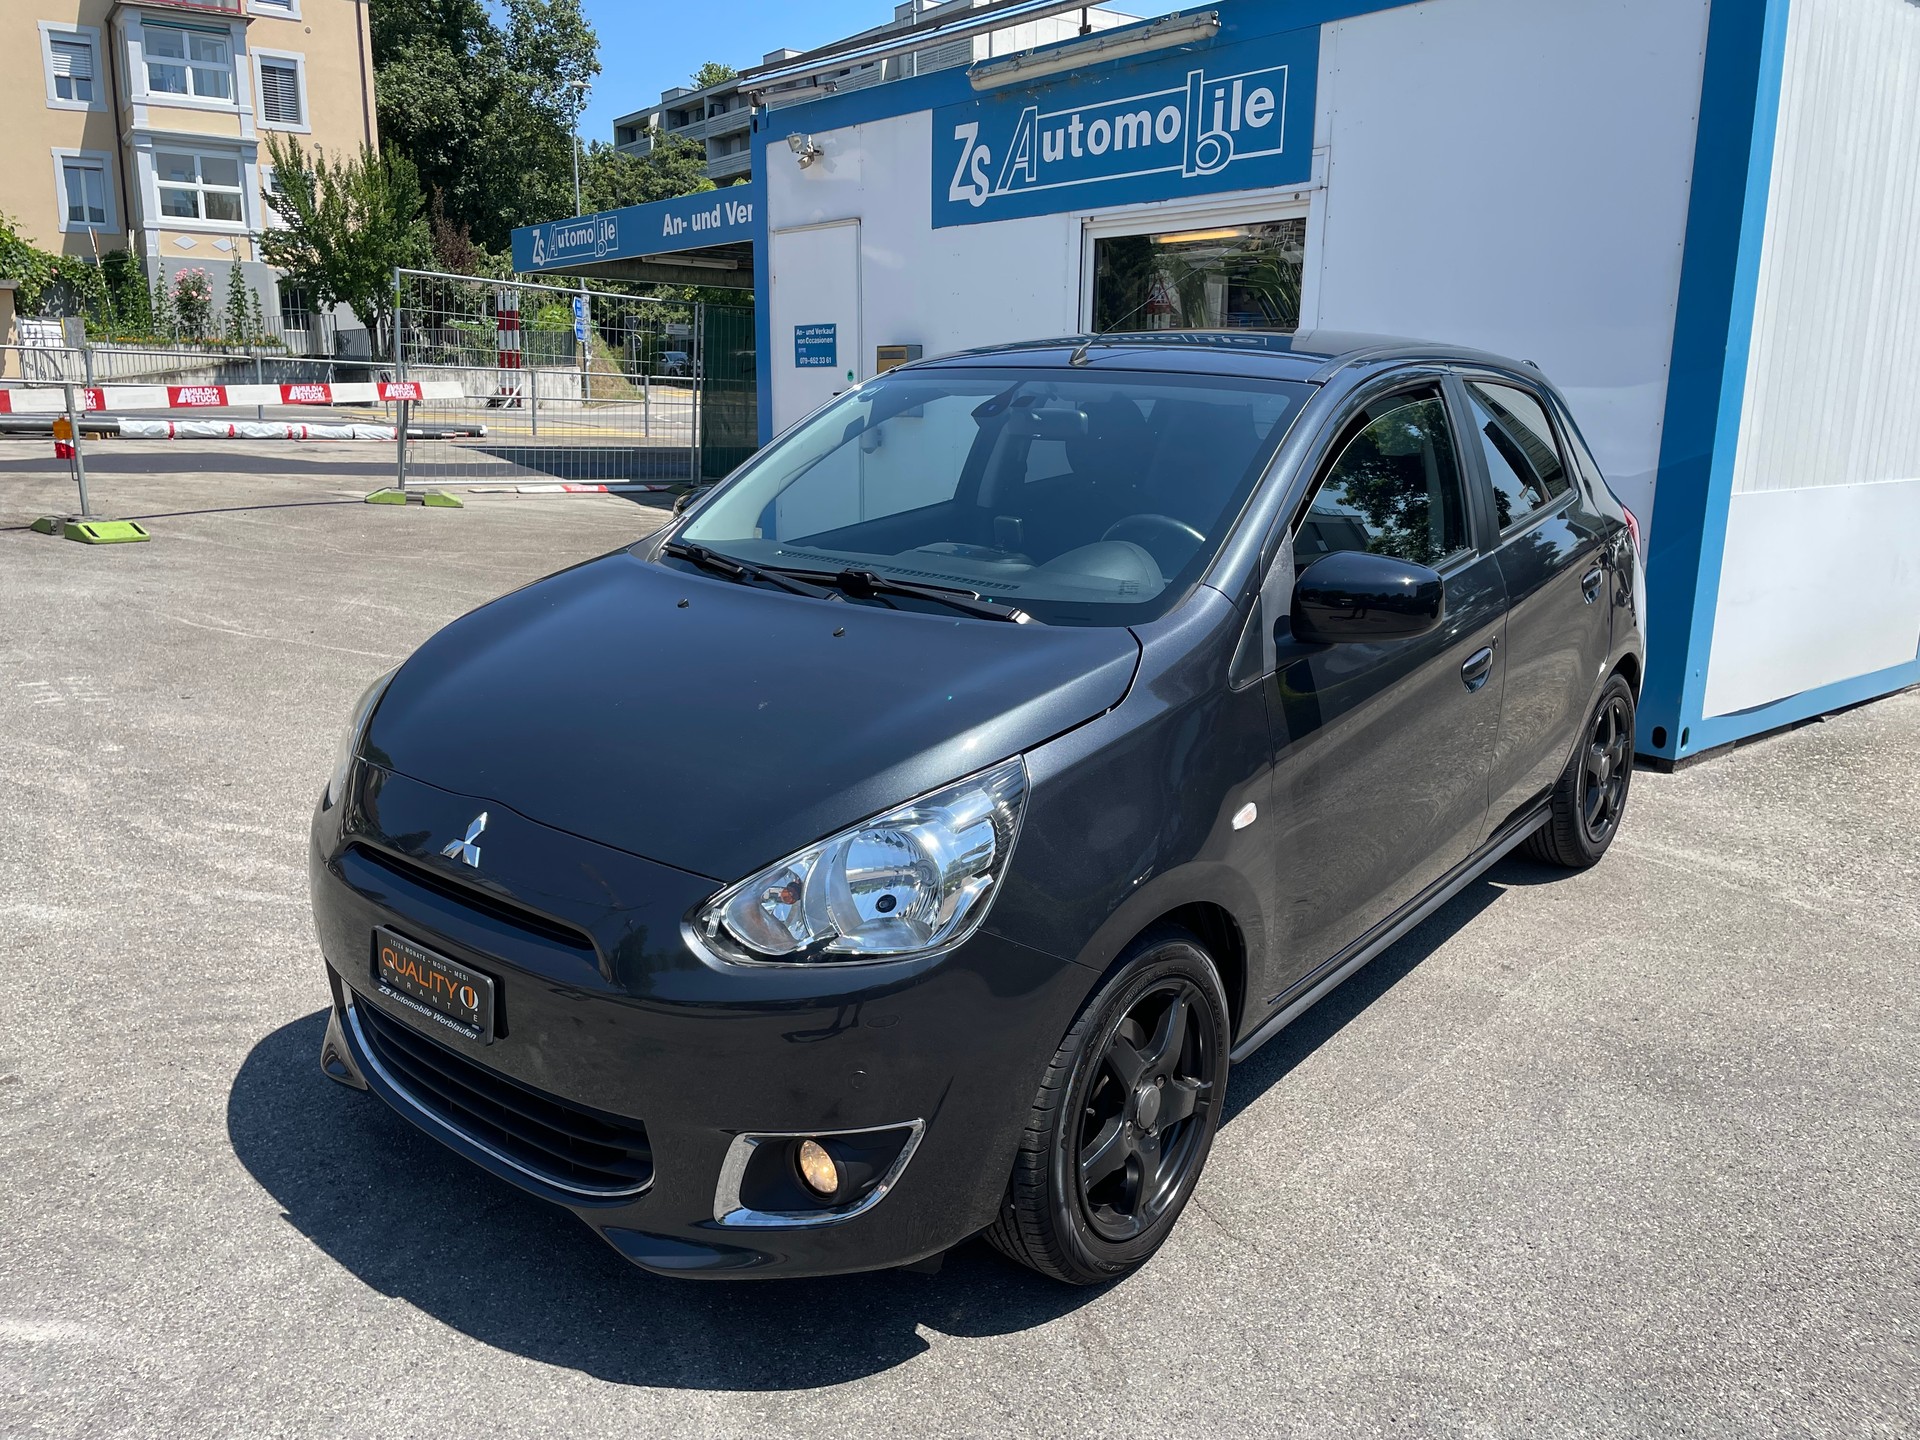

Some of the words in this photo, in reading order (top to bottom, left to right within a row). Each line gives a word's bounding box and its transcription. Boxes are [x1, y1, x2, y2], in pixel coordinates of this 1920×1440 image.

[995, 69, 1276, 191] Automobile
[546, 215, 616, 258] Automobile
[662, 213, 688, 237] An-
[691, 203, 721, 231] und
[815, 327, 834, 335] Verkauf
[405, 946, 426, 962] MONATE
[432, 960, 447, 972] MOIS
[454, 970, 470, 982] MESI
[382, 968, 478, 1022] GARANTIE
[390, 991, 432, 1017] Automobile
[432, 1012, 477, 1040] Worblaufen
